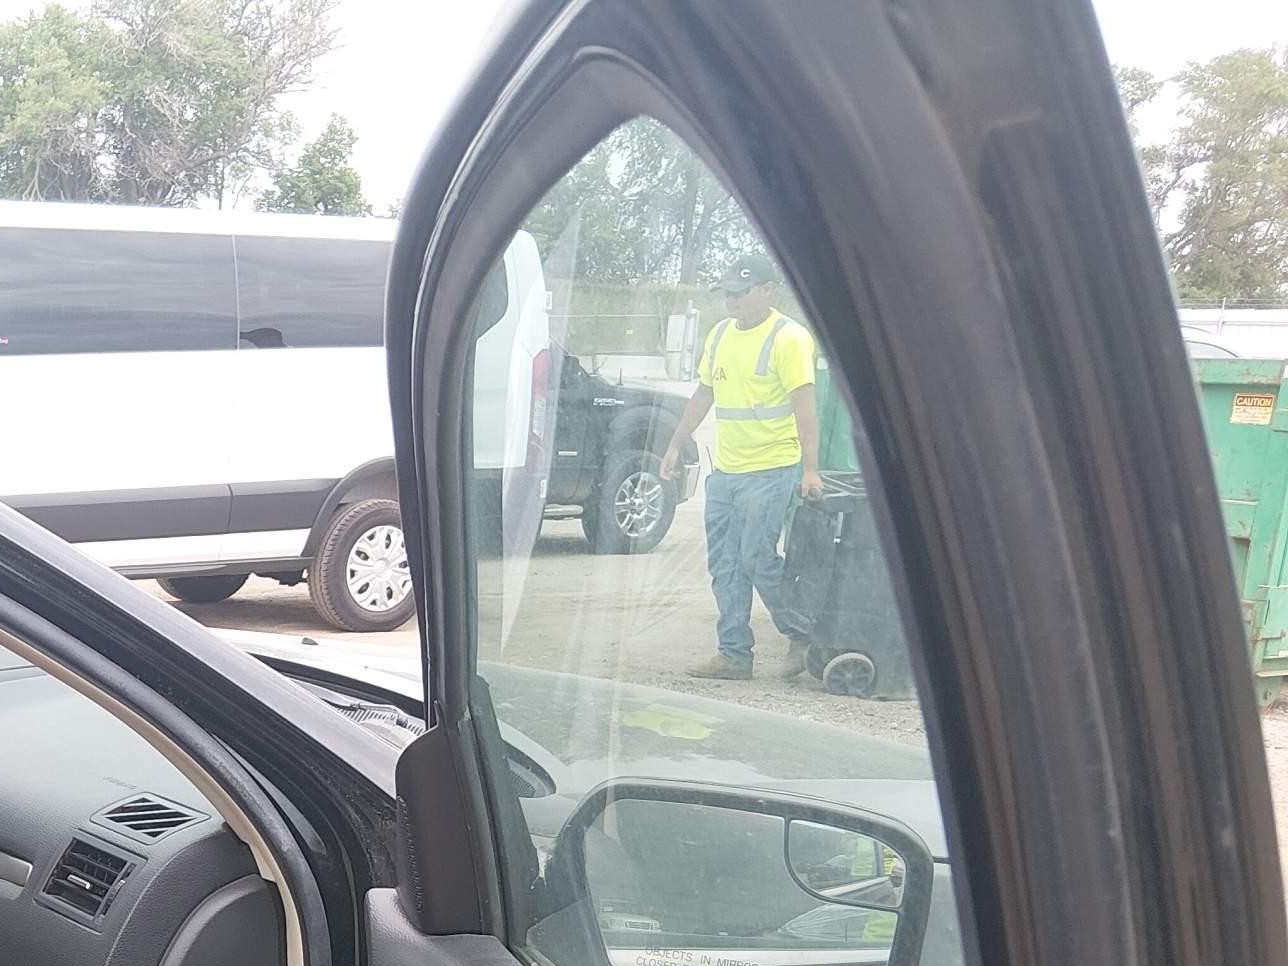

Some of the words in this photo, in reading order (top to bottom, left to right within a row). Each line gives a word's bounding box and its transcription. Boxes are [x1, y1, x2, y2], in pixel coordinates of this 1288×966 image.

[1236, 397, 1272, 407] CAUTION
[645, 945, 693, 962] OBJECTS
[700, 954, 712, 965] IN
